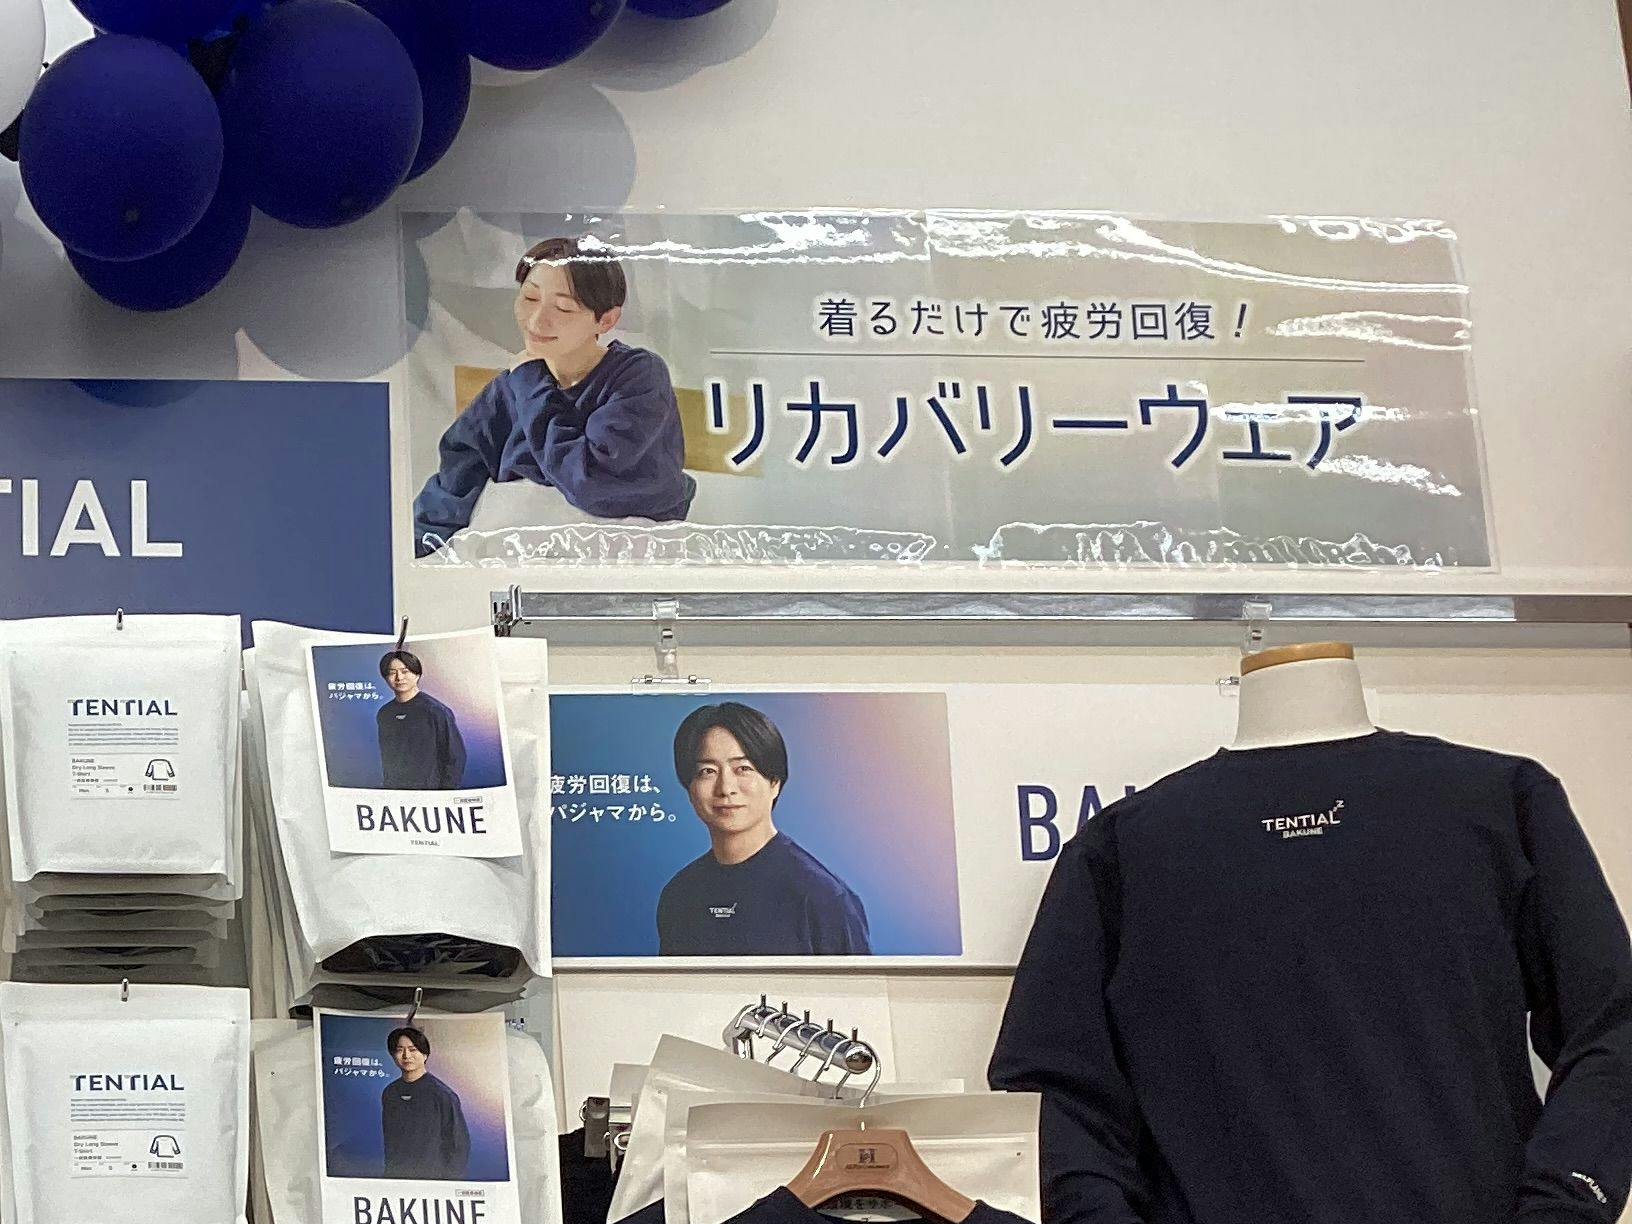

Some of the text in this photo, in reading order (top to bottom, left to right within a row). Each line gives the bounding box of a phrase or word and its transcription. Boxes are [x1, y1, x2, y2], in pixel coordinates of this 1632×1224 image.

[709, 380, 1364, 470] リカバリーウェア
[67, 699, 178, 716] TENTIAL
[356, 804, 487, 834] BAKUNE
[69, 1074, 185, 1092] TENTIAL
